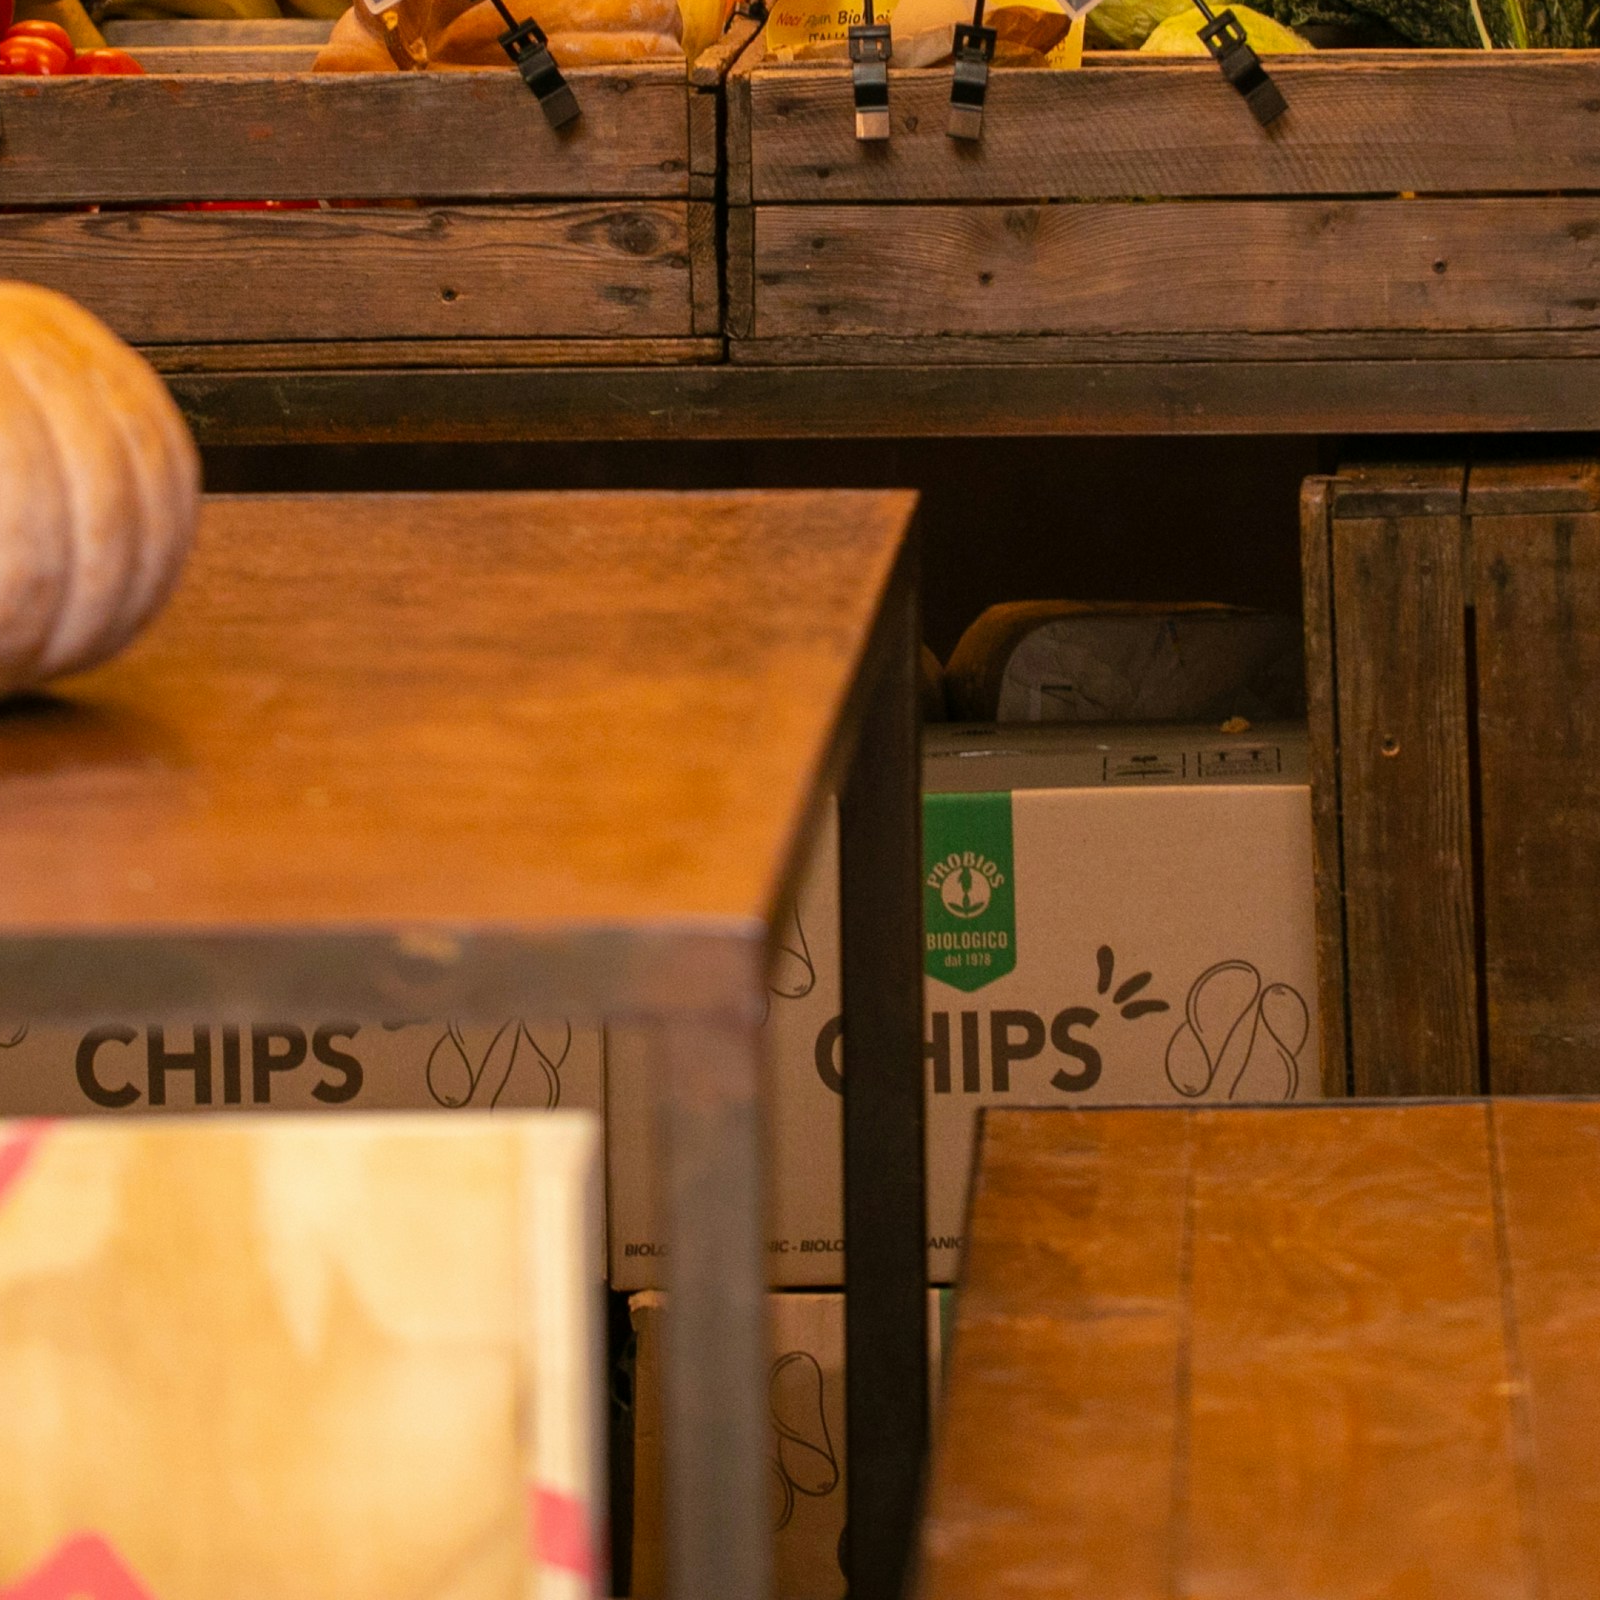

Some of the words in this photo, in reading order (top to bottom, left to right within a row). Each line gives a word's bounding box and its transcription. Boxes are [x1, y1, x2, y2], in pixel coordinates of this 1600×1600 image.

[926, 850, 1006, 890] PROBIOS
[926, 930, 1009, 951] BIOLOGICO
[944, 953, 963, 968] dal
[965, 953, 992, 968] 1978
[75, 1021, 365, 1109] CHIPS
